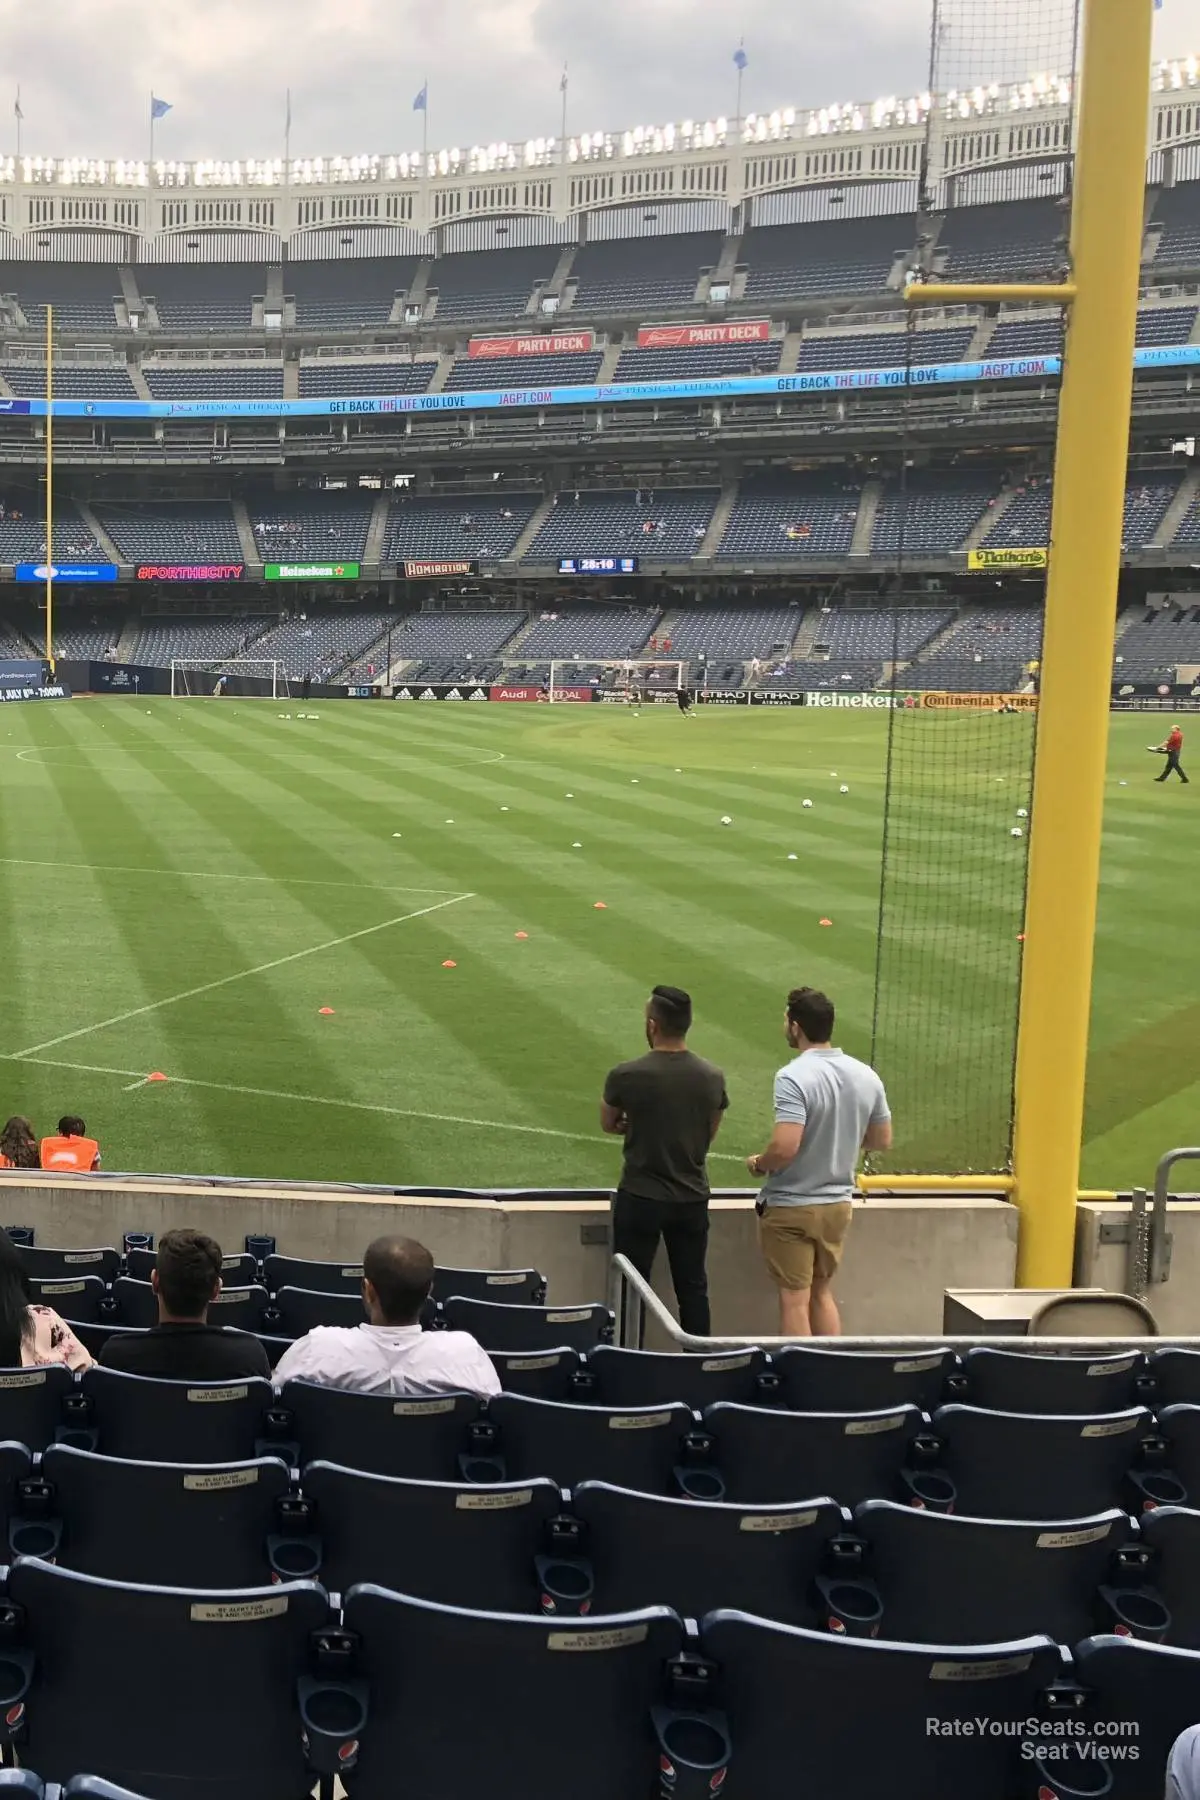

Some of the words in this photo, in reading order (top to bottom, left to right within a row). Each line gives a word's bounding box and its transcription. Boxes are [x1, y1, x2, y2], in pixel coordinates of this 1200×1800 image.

[688, 328, 726, 342] PARTY
[729, 325, 761, 339] DECK
[517, 340, 552, 352] PARTY
[554, 337, 584, 350] DECK
[777, 378, 796, 391] GET
[800, 376, 831, 389] BACK
[834, 375, 855, 387] THE
[858, 373, 880, 386] LIFE
[884, 371, 908, 384] YOU
[910, 369, 939, 382] LOVE
[977, 361, 1046, 378] JAGPT.COM
[330, 402, 346, 412] GET
[349, 401, 375, 412] BACK
[378, 400, 396, 411] THE
[400, 399, 417, 410] LIFE
[420, 397, 440, 409] YOU
[442, 396, 465, 407] LOVE
[499, 391, 552, 405] JAGPT.COM
[138, 565, 243, 579] #FORTHECITY
[279, 566, 333, 577] Heineken
[408, 562, 470, 576] ADMIRATION
[6, 689, 22, 700] JULY
[38, 687, 64, 698] 7:00PM
[500, 690, 527, 699] Audi
[754, 692, 800, 700] ETIHAD
[806, 692, 897, 708] Heineken
[924, 694, 994, 708] Continental
